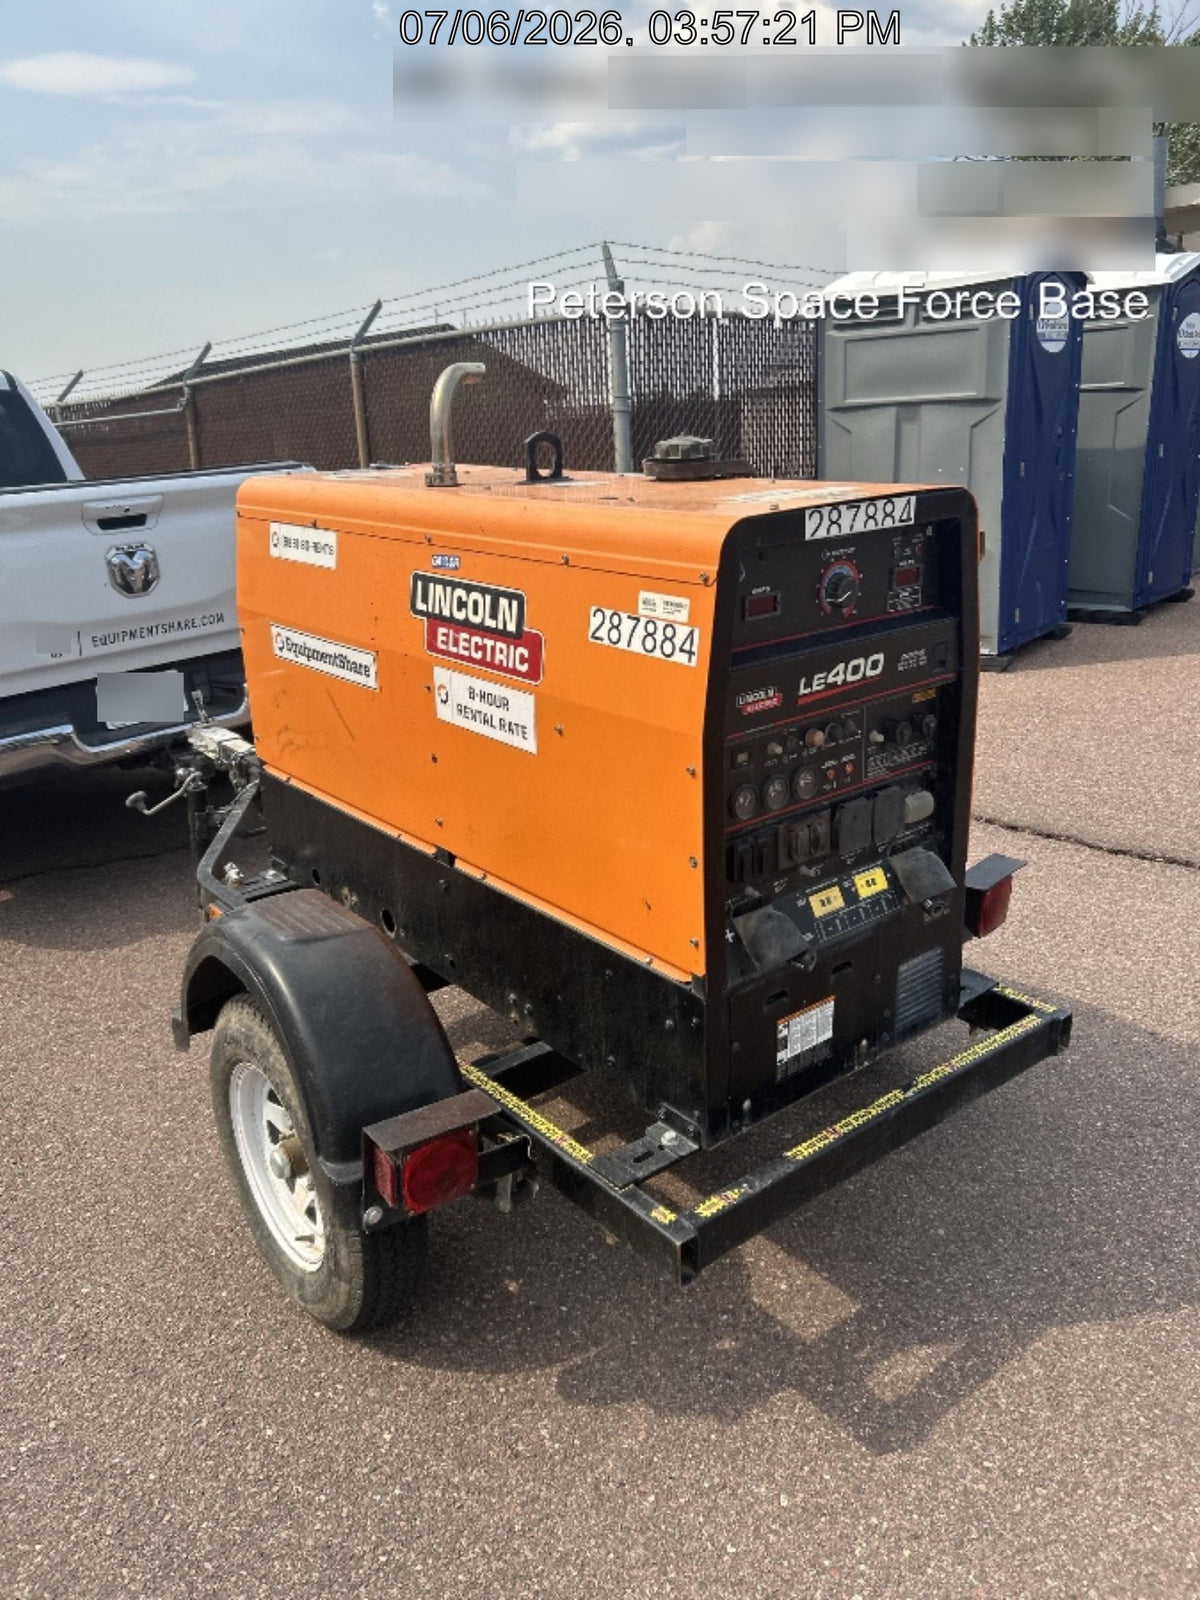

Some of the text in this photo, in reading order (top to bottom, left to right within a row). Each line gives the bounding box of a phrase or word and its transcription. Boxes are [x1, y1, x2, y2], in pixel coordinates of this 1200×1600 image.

[808, 498, 912, 537] 287884
[416, 580, 518, 633] LINCOLN
[91, 612, 225, 648] EQUIPMENTSHARE.COM
[436, 627, 529, 673] ELECTRIC
[591, 608, 695, 663] 287884
[284, 636, 371, 678] EquipmentShare
[798, 652, 885, 696] LE400
[468, 686, 510, 712] 8-HOUR
[456, 703, 529, 741] RENTAL RATE
